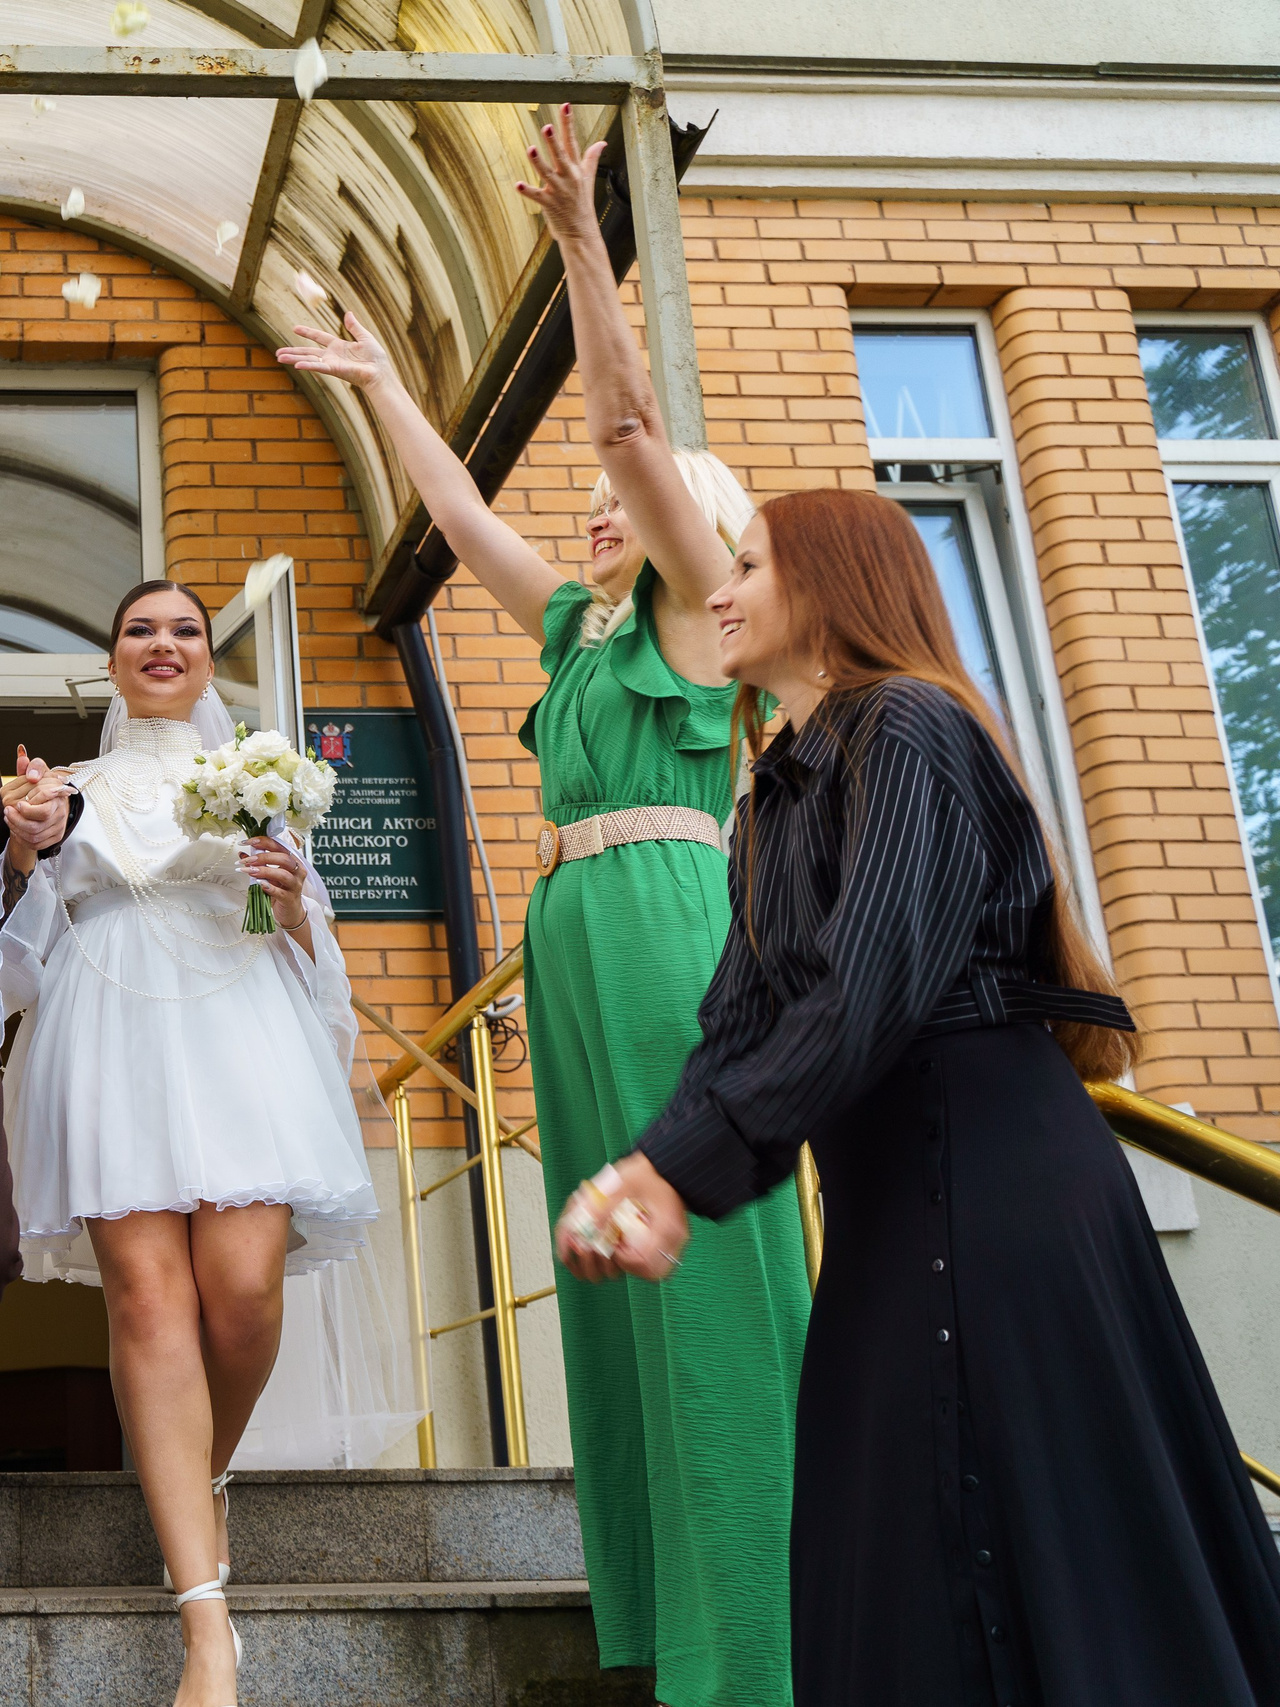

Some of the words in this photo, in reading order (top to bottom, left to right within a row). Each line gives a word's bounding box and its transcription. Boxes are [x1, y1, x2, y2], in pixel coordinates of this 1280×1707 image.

[382, 818, 436, 830] АКТОВ
[312, 852, 392, 866] СТОЯНИЯ
[366, 875, 418, 886] РАЙОНА
